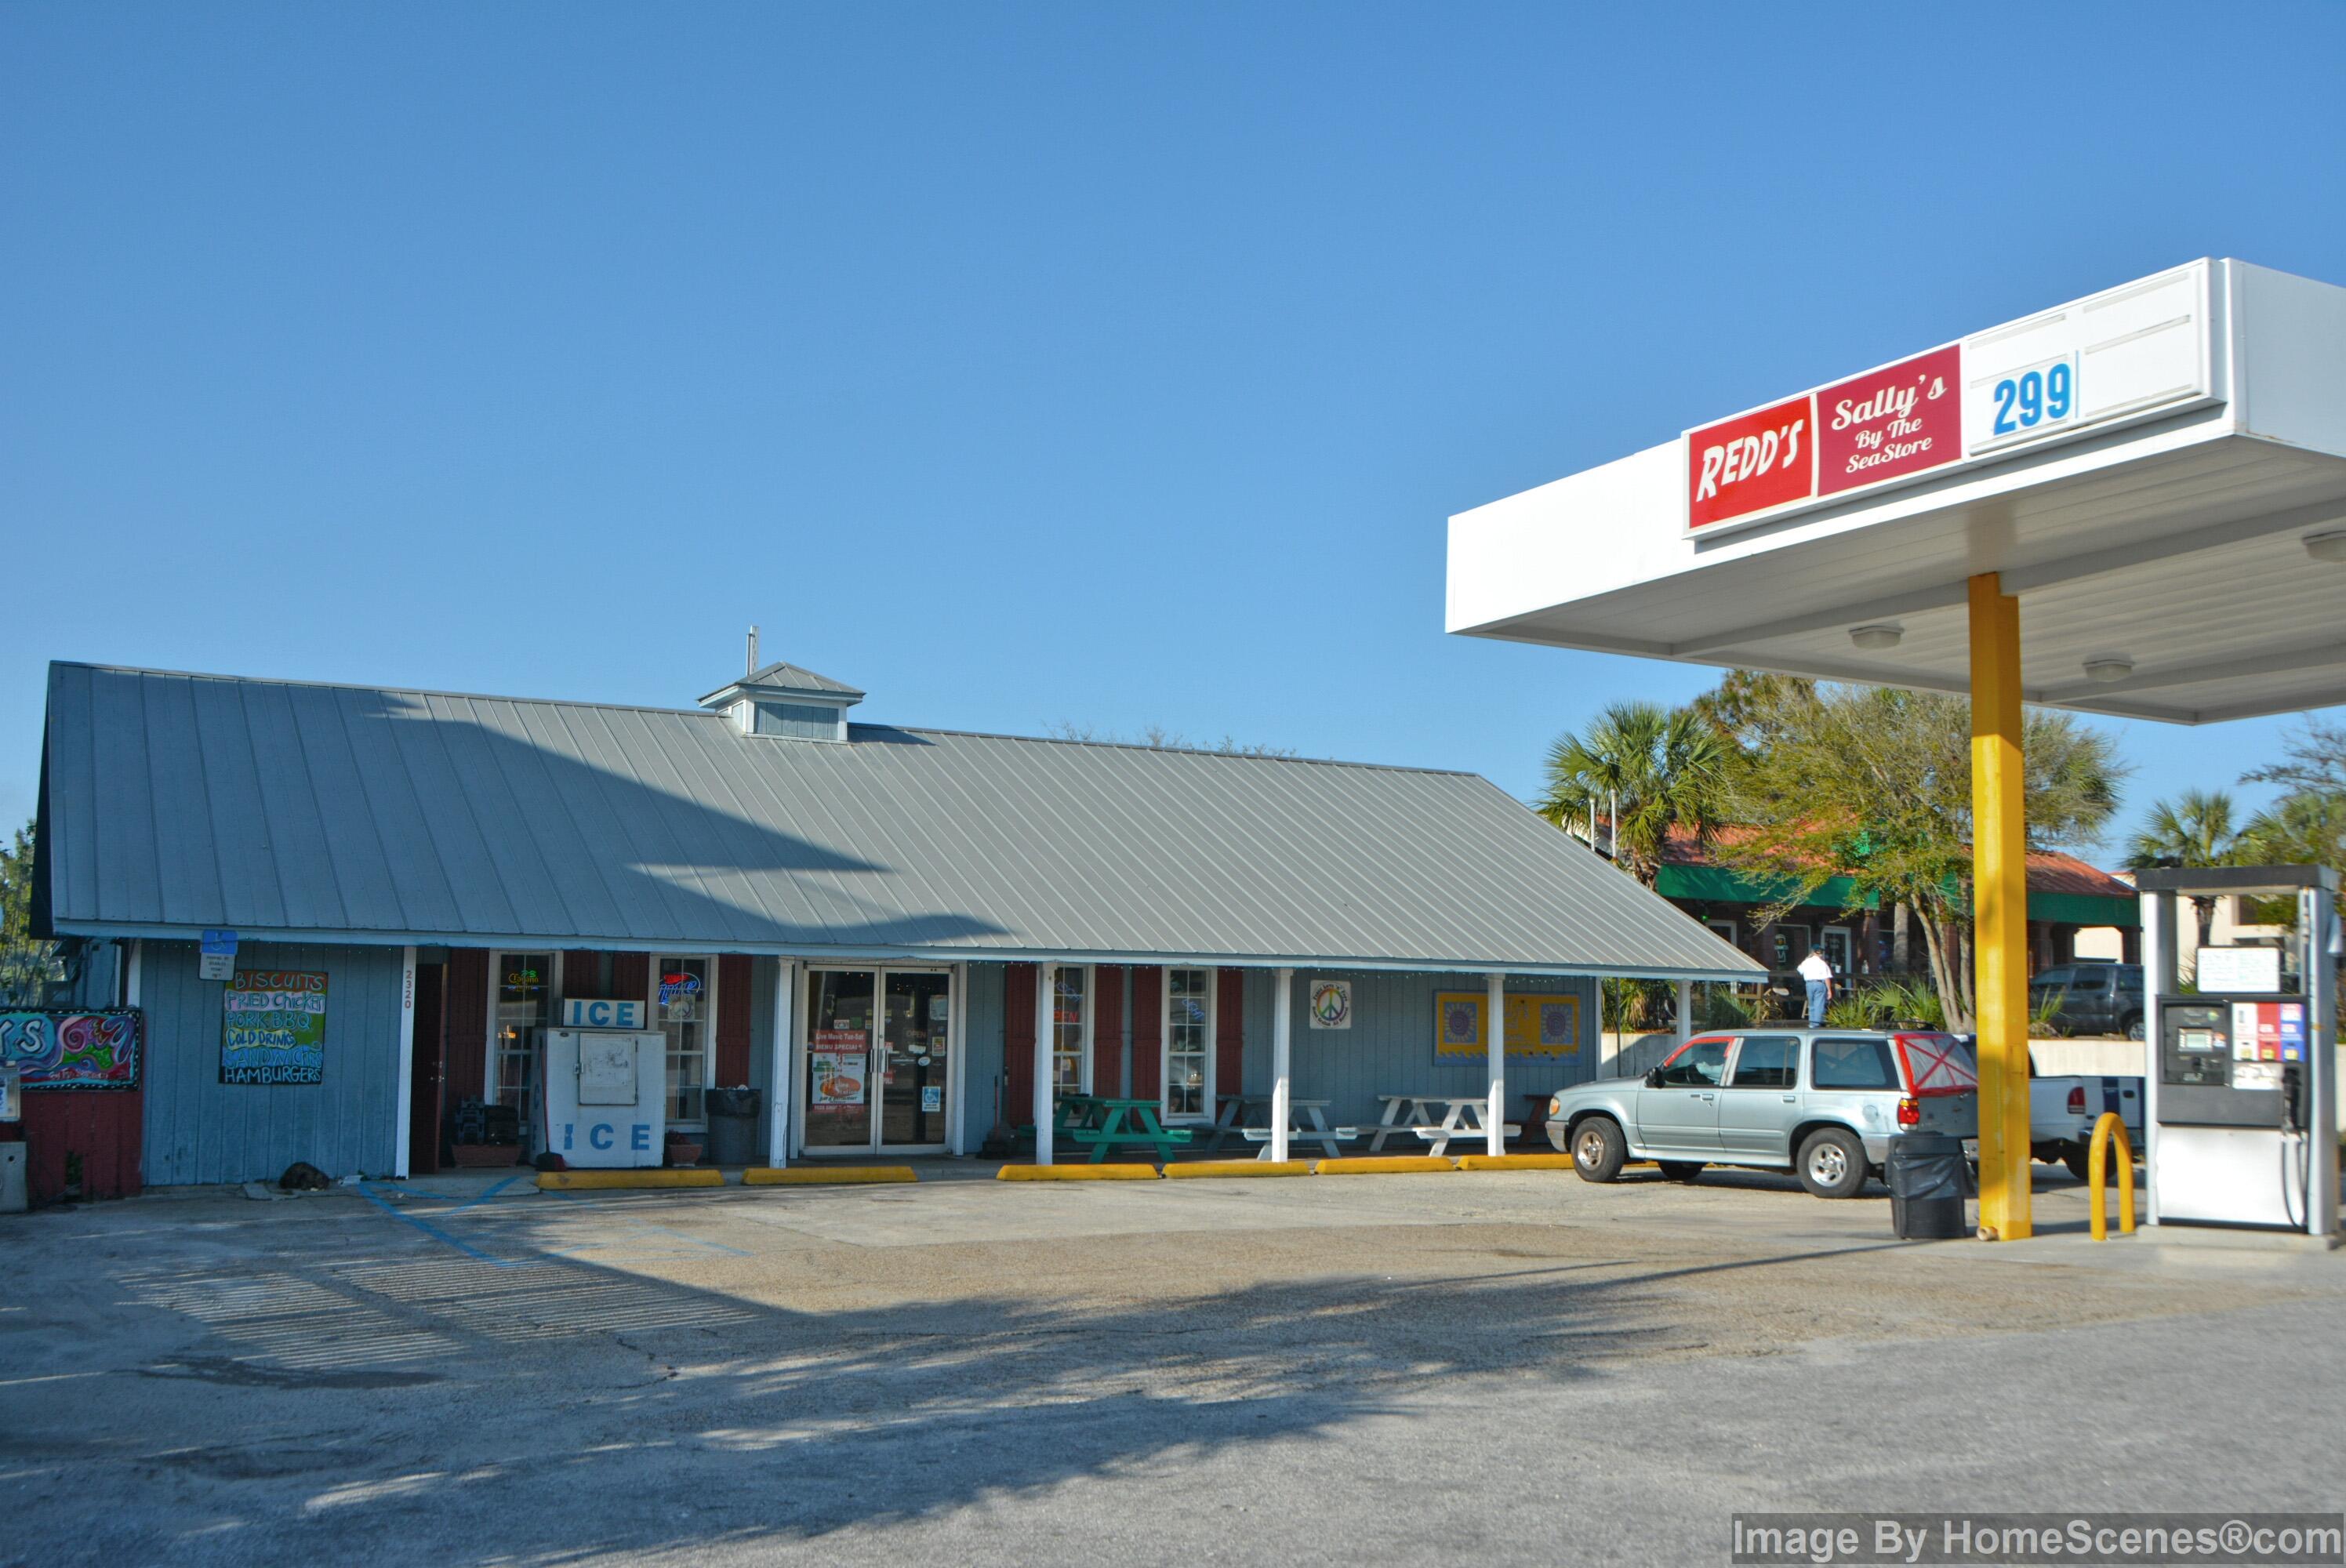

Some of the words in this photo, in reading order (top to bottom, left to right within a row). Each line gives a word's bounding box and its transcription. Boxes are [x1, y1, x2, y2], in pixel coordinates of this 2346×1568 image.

[1831, 374, 1948, 430] Sally's
[1992, 363, 2070, 435] 299
[1855, 430, 1883, 450] By
[1887, 418, 1923, 438] The
[1696, 419, 1804, 503] REDD'S
[235, 972, 324, 991] BISCUITS
[227, 991, 270, 1009] FRIED
[226, 1010, 269, 1029] PORK
[271, 1010, 311, 1029] BBQ
[573, 1001, 634, 1026] ICE
[259, 1030, 295, 1047] DRINKS
[906, 1029, 927, 1038] OPEN
[224, 1066, 321, 1083] HAMBURGERS
[564, 1123, 650, 1150] ICE
